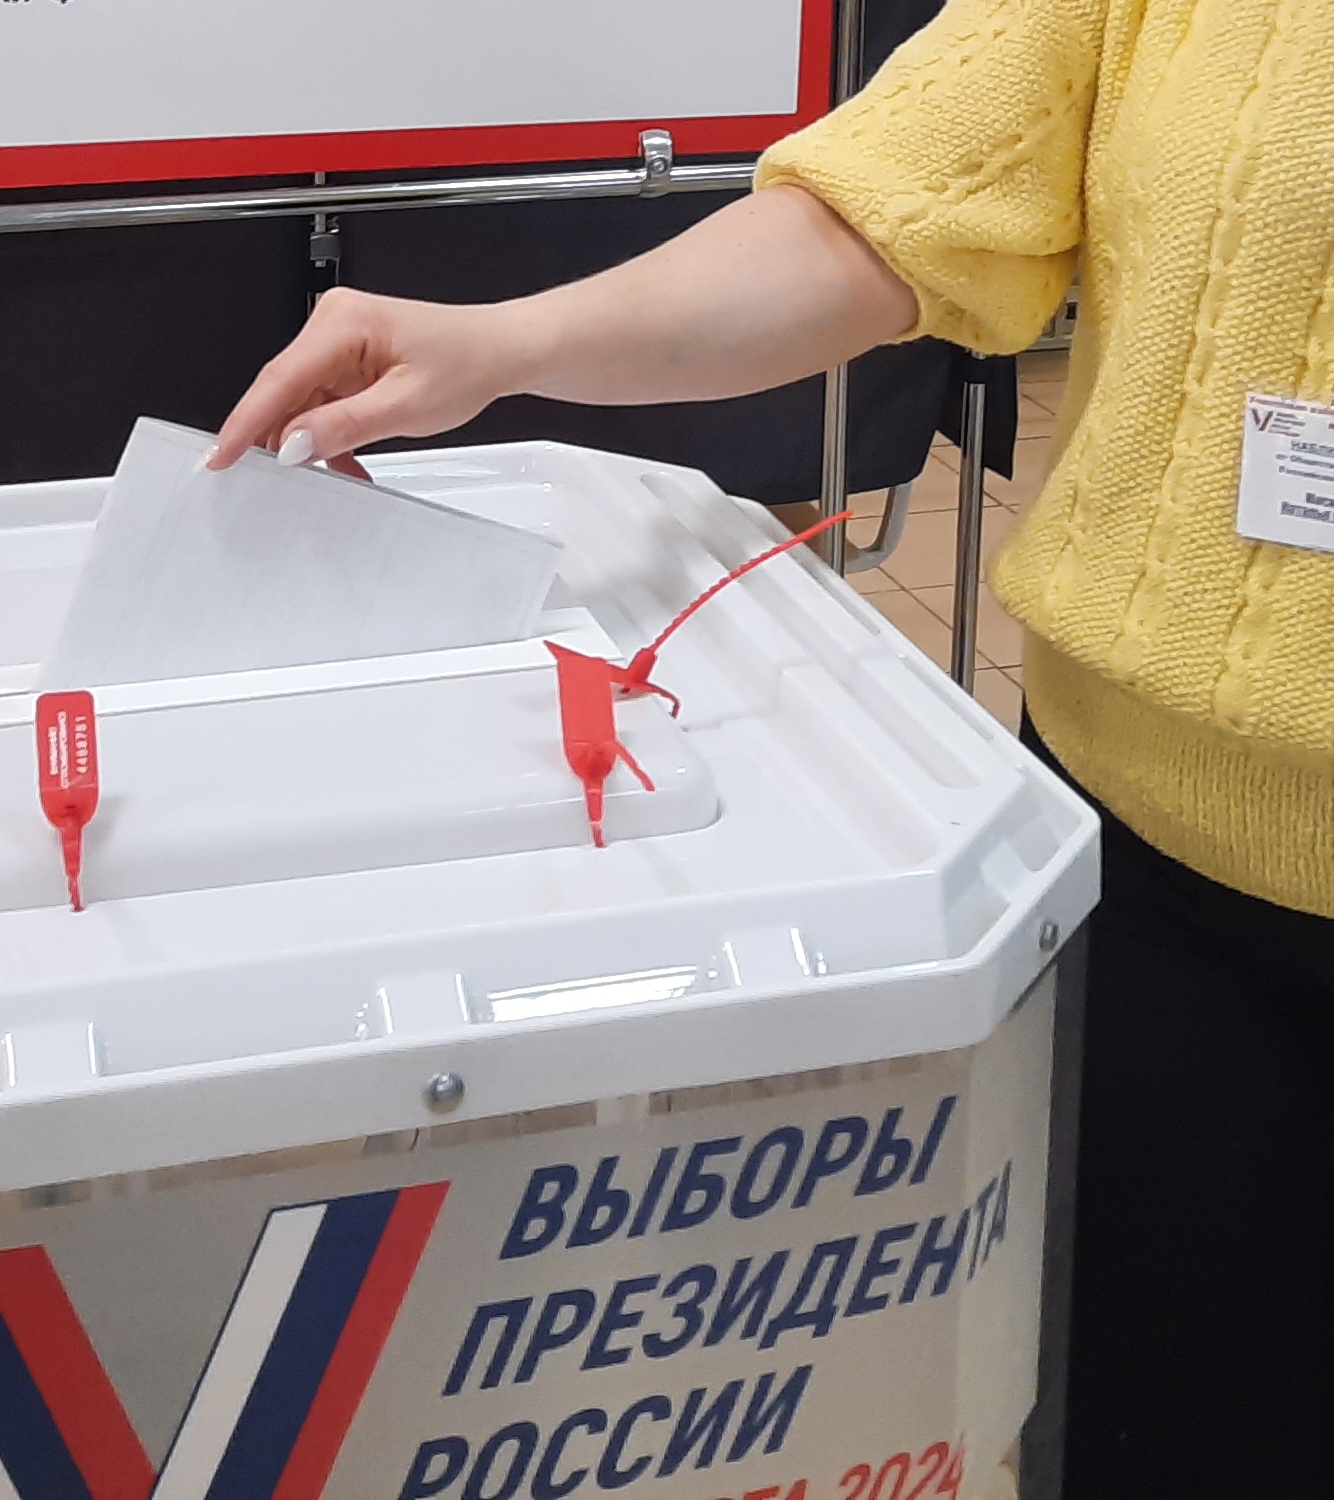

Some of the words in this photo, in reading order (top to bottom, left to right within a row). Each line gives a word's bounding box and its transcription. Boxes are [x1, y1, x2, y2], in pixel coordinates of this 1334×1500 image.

[498, 1095, 958, 1260] ВЫБОРЫ
[441, 1160, 1012, 1398] ПРЕЗИДЕНТА
[397, 1365, 813, 1500] РОССИИ
